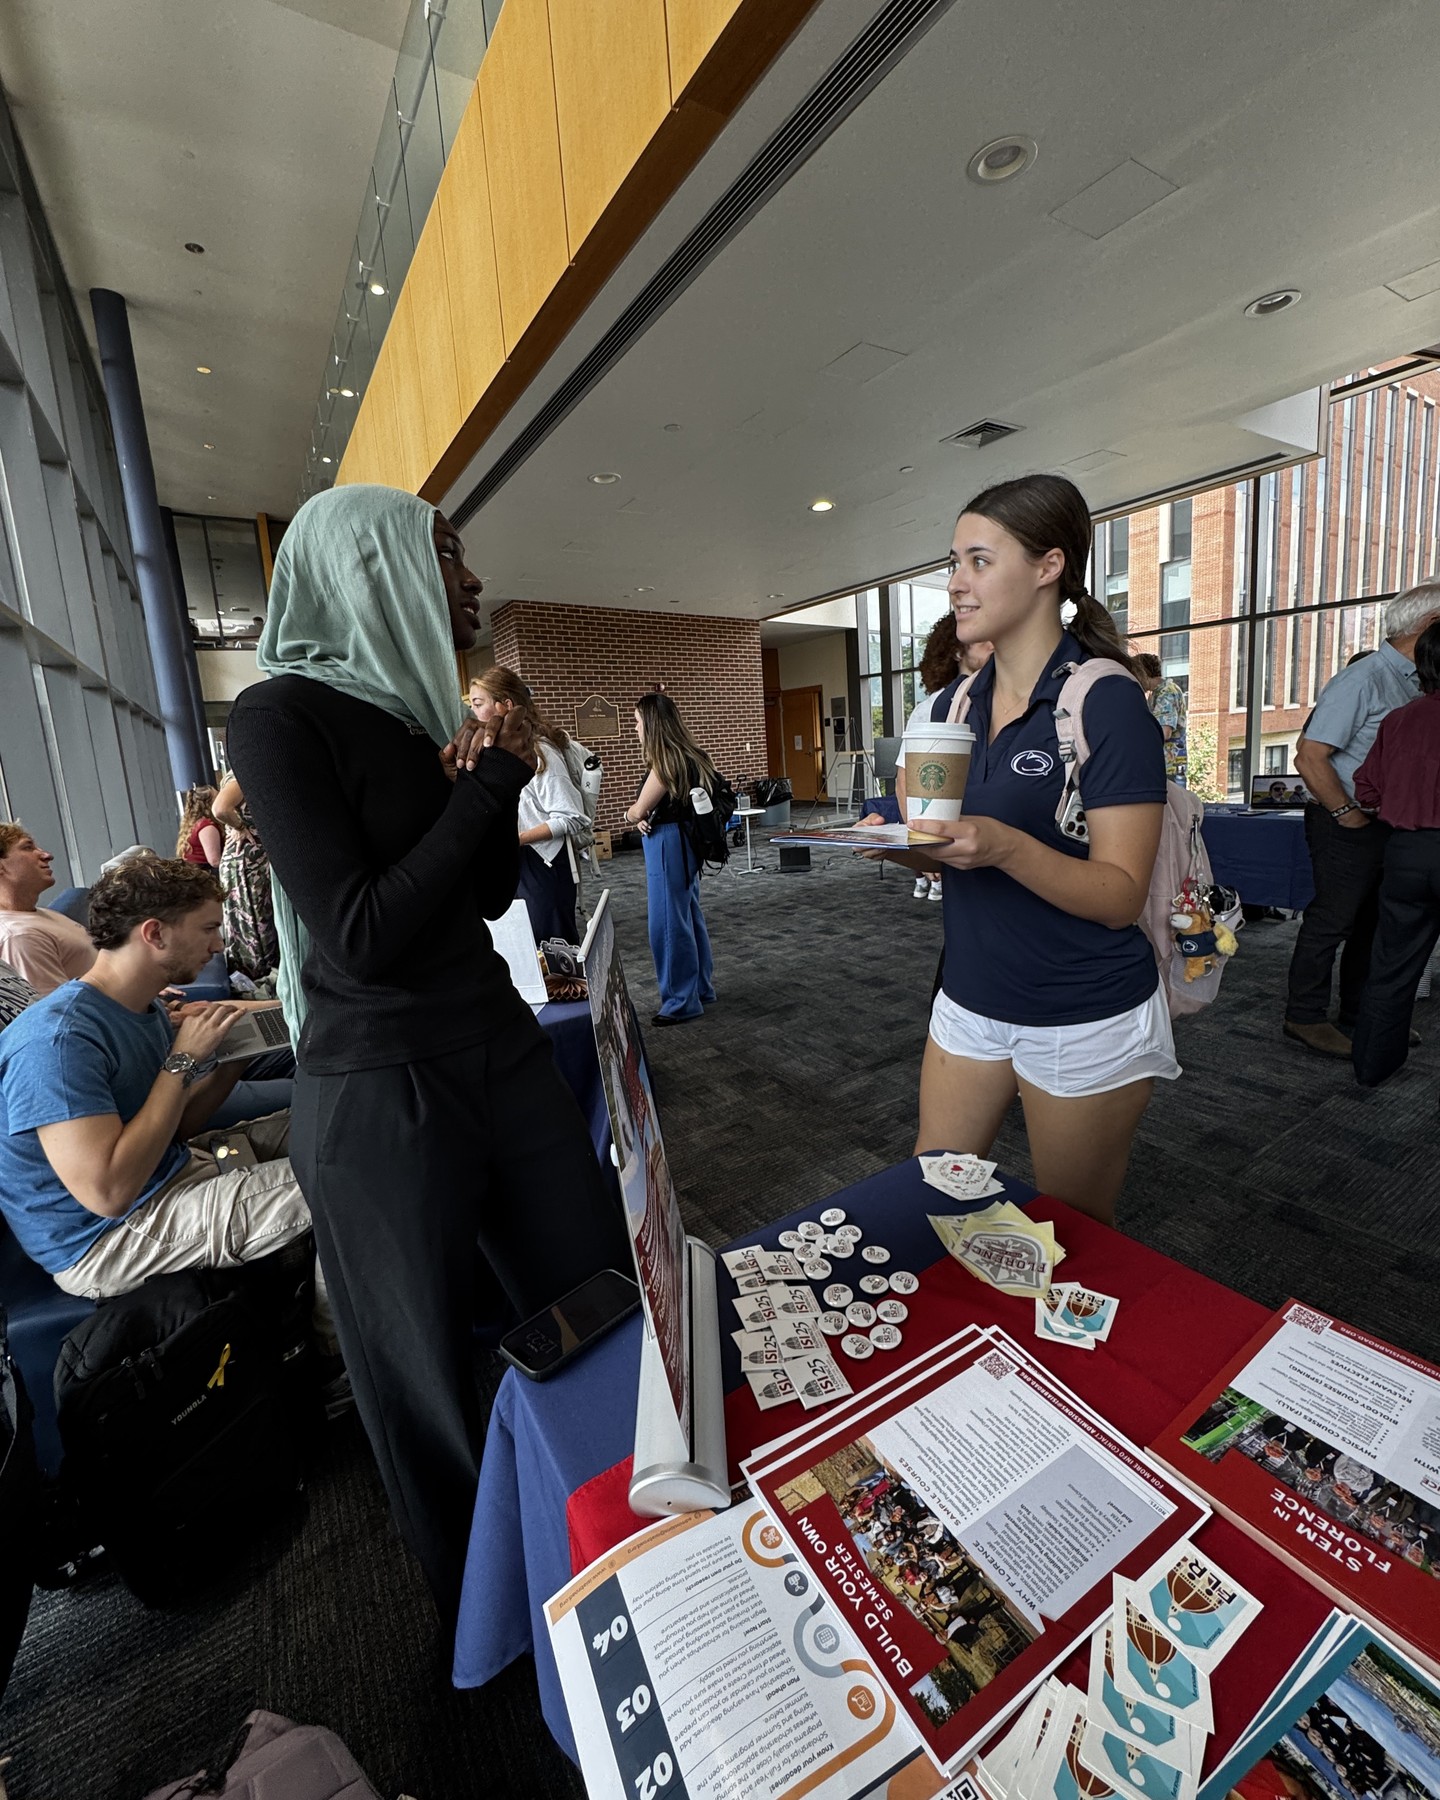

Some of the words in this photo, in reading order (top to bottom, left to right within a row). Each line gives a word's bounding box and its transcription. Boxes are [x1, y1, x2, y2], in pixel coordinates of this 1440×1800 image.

[961, 1239, 1047, 1273] FLORENCE
[1075, 1290, 1105, 1306] FLR
[1288, 1363, 1323, 1385] (SPRING)
[1329, 1358, 1369, 1382] ELECTIVES
[1322, 1382, 1359, 1404] COURSES
[1369, 1378, 1412, 1404] RELEVANT
[1018, 1371, 1097, 1434] ADMISSIONS@ISIABROAD.ORG
[1274, 1398, 1302, 1417] (FALL):
[1359, 1401, 1398, 1426] BIOLOGY
[1302, 1413, 1340, 1438] COURSES
[1093, 1431, 1120, 1453] CONTACT
[1340, 1435, 1377, 1460] PHYSICS
[1117, 1450, 1134, 1464] INFO
[1413, 1456, 1439, 1475] WITH
[897, 1456, 931, 1492] COURSES
[1131, 1462, 1151, 1479] MORE
[1148, 1476, 1164, 1489] FOR
[929, 1492, 961, 1526] SAMPLE
[1106, 1500, 1123, 1514] more!
[1121, 1512, 1133, 1523] And
[1147, 1499, 1166, 1515] NOTES:
[1272, 1505, 1291, 1522] IN
[795, 1515, 829, 1556] OWN
[1269, 1486, 1392, 1573] FLORENCE
[1294, 1520, 1363, 1574] STEM
[721, 1560, 734, 1571] your
[733, 1557, 742, 1565] Do
[971, 1539, 1016, 1587] FLORENCE
[684, 1574, 711, 1593] research!
[710, 1568, 722, 1578] own
[823, 1554, 867, 1611] YOUR
[833, 1541, 895, 1622] SEMESTER
[1186, 1557, 1237, 1606] FLR
[1014, 1586, 1037, 1610] WHY
[742, 1624, 758, 1637] Now!
[757, 1616, 771, 1628] Start
[588, 1611, 633, 1659] 04
[861, 1609, 914, 1679] BUILD
[767, 1665, 775, 1674] to
[774, 1656, 791, 1670] them
[754, 1669, 768, 1682] your
[759, 1664, 795, 1692] Scholarships
[785, 1674, 800, 1687] Plan
[721, 1695, 729, 1704] so
[728, 1678, 755, 1700] calendar
[744, 1687, 760, 1701] have
[765, 1682, 787, 1701] ahead!
[611, 1680, 656, 1734] 03
[708, 1699, 722, 1713] you
[722, 1695, 745, 1716] varying
[783, 1690, 808, 1711] summer
[792, 1699, 814, 1719] Spring
[697, 1708, 710, 1722] can
[762, 1707, 784, 1726] before.
[780, 1713, 794, 1727] and
[792, 1709, 818, 1731] whereas
[671, 1717, 699, 1742] prepare
[754, 1721, 782, 1745] Summer
[792, 1718, 823, 1744] programs
[678, 1736, 693, 1752] Add
[758, 1726, 794, 1756] scholarship
[771, 1738, 794, 1760] usually
[789, 1729, 828, 1761] Scholarships
[815, 1741, 834, 1760] Know
[723, 1739, 756, 1767] programs
[755, 1754, 773, 1772] close
[780, 1755, 791, 1768] for
[800, 1752, 816, 1769] your
[631, 1747, 678, 1800] 02
[706, 1762, 725, 1781] open
[720, 1749, 760, 1784] applications
[747, 1766, 756, 1777] in
[752, 1762, 782, 1788] Full-Year
[695, 1777, 709, 1792] the
[711, 1779, 722, 1793] for
[736, 1772, 749, 1786] the
[767, 1764, 802, 1794] deadlines!
